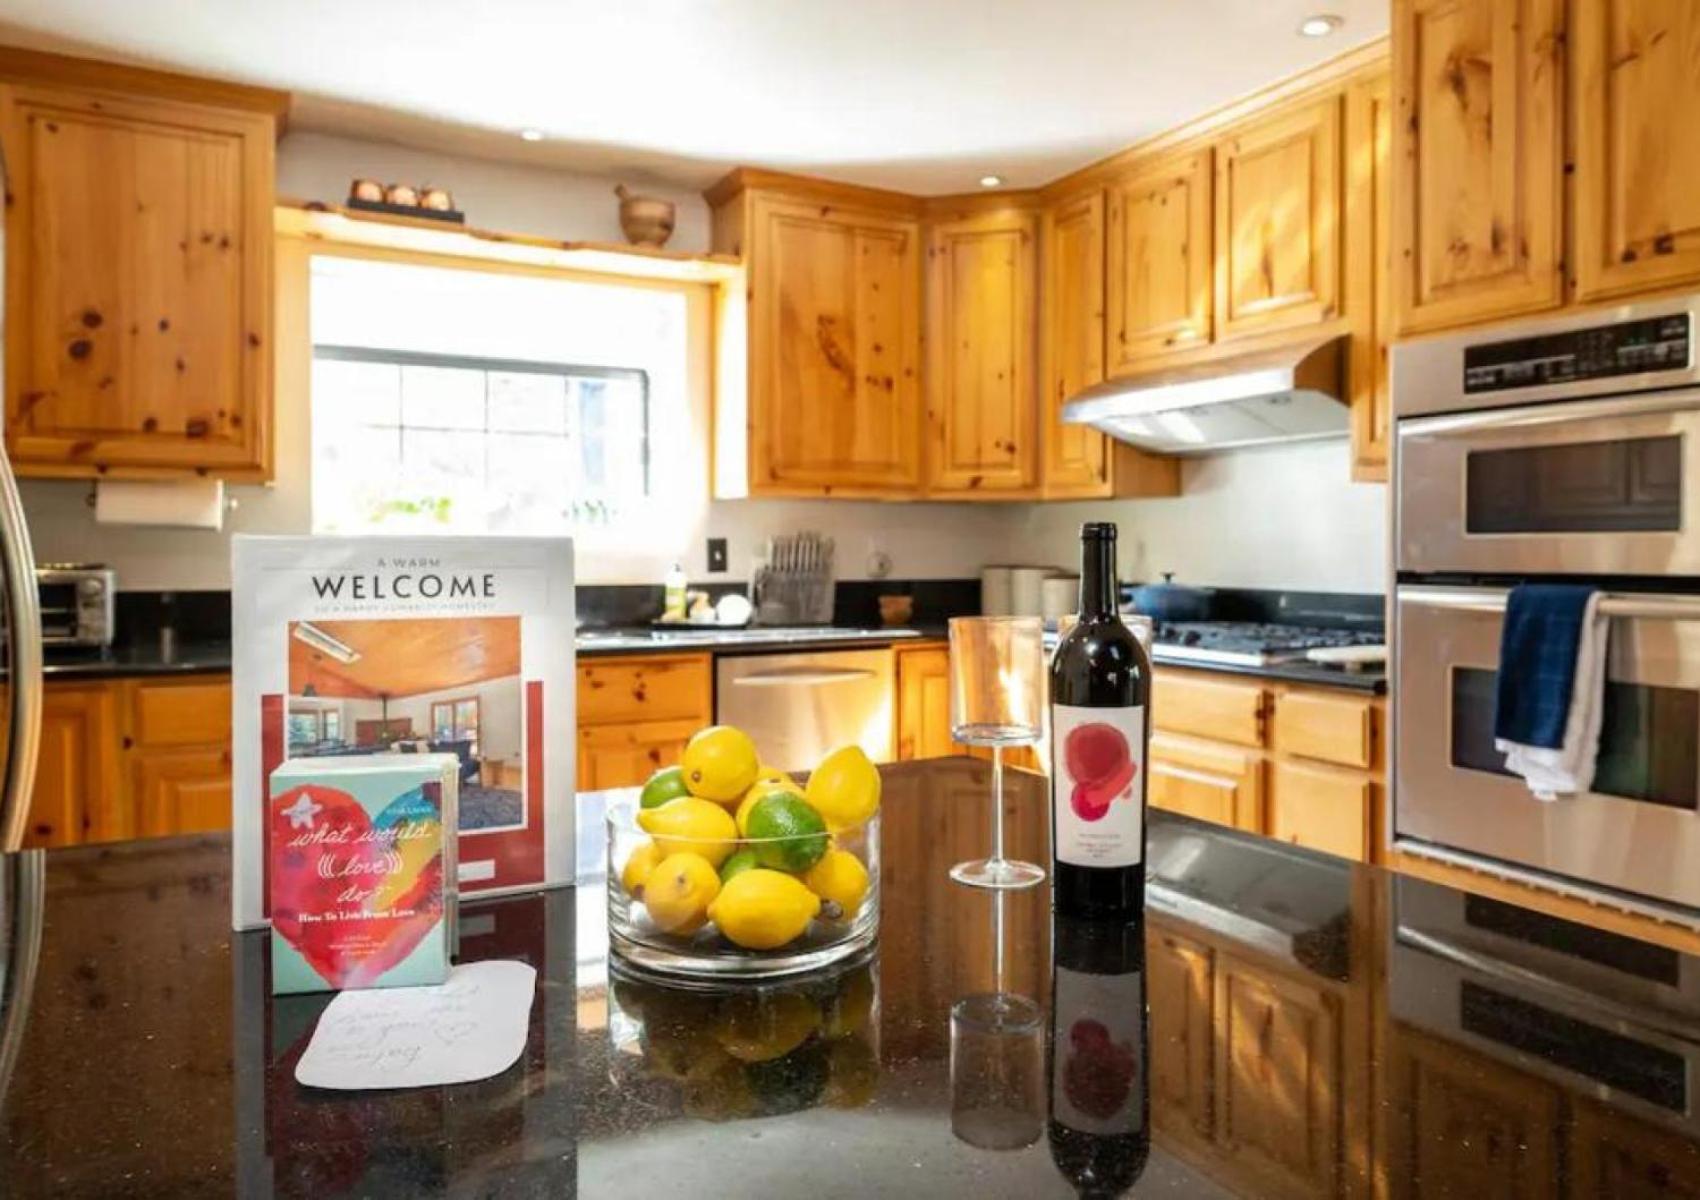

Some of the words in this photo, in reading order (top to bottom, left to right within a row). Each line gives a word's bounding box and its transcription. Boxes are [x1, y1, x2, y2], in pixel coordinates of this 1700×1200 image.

[377, 557, 386, 568] A
[391, 557, 441, 568] WARM
[312, 574, 497, 599] WELCOME
[288, 821, 353, 847] what
[352, 821, 433, 844] would
[298, 912, 322, 923] How
[324, 912, 338, 921] To
[391, 908, 415, 919] Love
